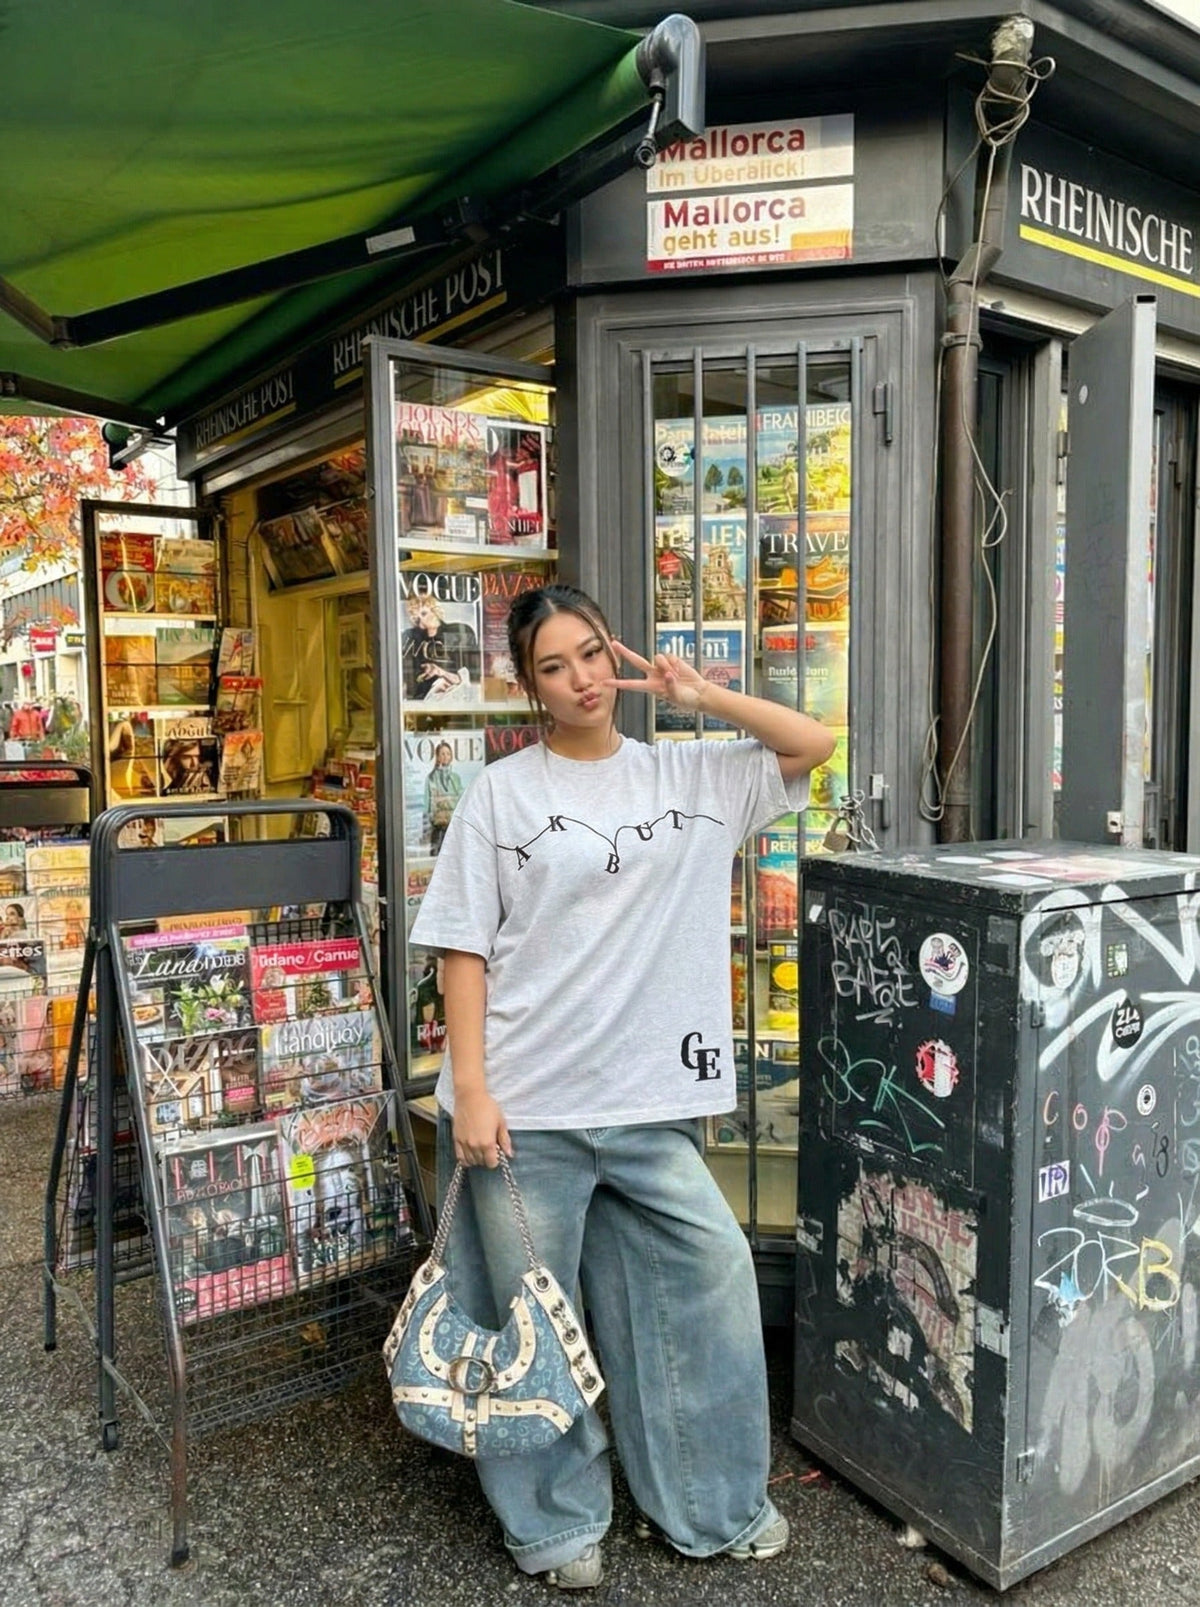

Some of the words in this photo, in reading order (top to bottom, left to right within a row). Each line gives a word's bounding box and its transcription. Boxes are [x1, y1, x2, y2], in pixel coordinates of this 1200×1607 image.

[659, 127, 806, 164] Mallorca
[664, 196, 806, 229] Mallorca
[1020, 163, 1193, 274] RHEINISCHE
[663, 229, 718, 257] geht
[728, 223, 780, 247] aus!
[446, 249, 504, 315] POST
[195, 396, 260, 450] RHEINISCHE
[261, 368, 294, 414] POST
[398, 571, 482, 603] VOGUE
[404, 736, 484, 763] VOUE
